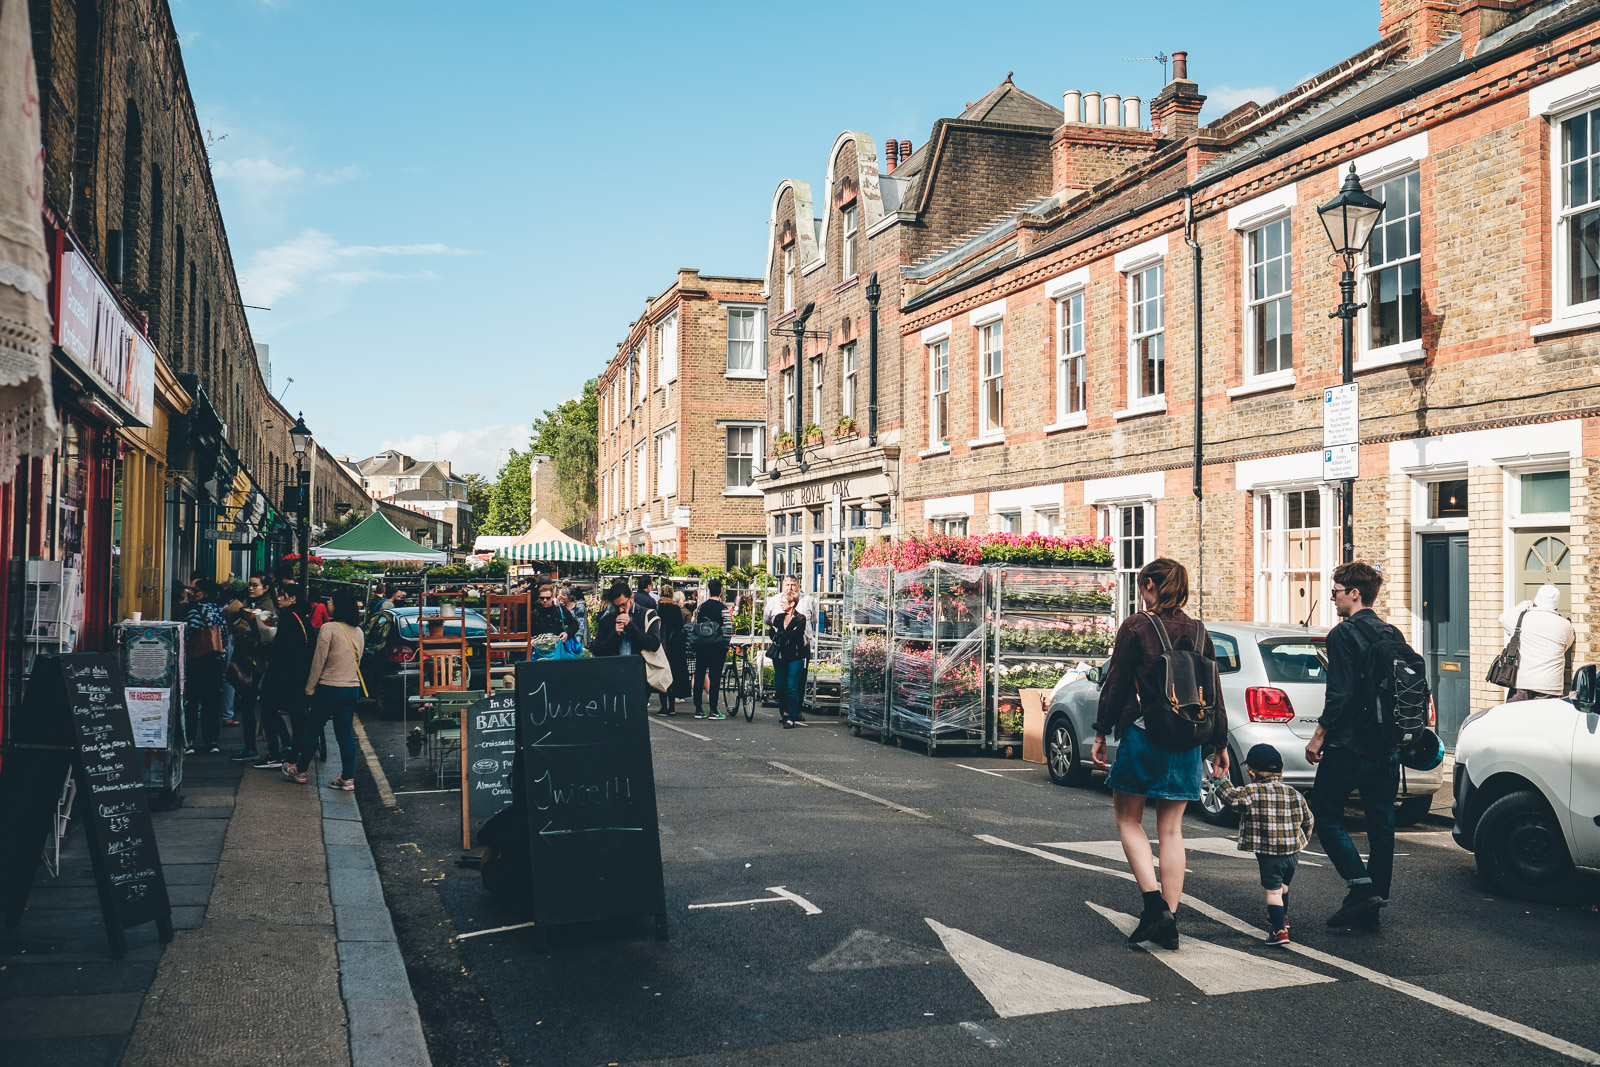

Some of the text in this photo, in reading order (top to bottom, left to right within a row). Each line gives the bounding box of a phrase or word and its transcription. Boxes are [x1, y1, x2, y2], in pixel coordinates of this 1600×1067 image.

[781, 479, 850, 507] THE ROYAL OAK
[206, 530, 241, 541] COFFEE
[490, 698, 515, 709] In St
[476, 712, 515, 730] BAK
[476, 781, 502, 790] Almond
[492, 787, 513, 796] Croiss
